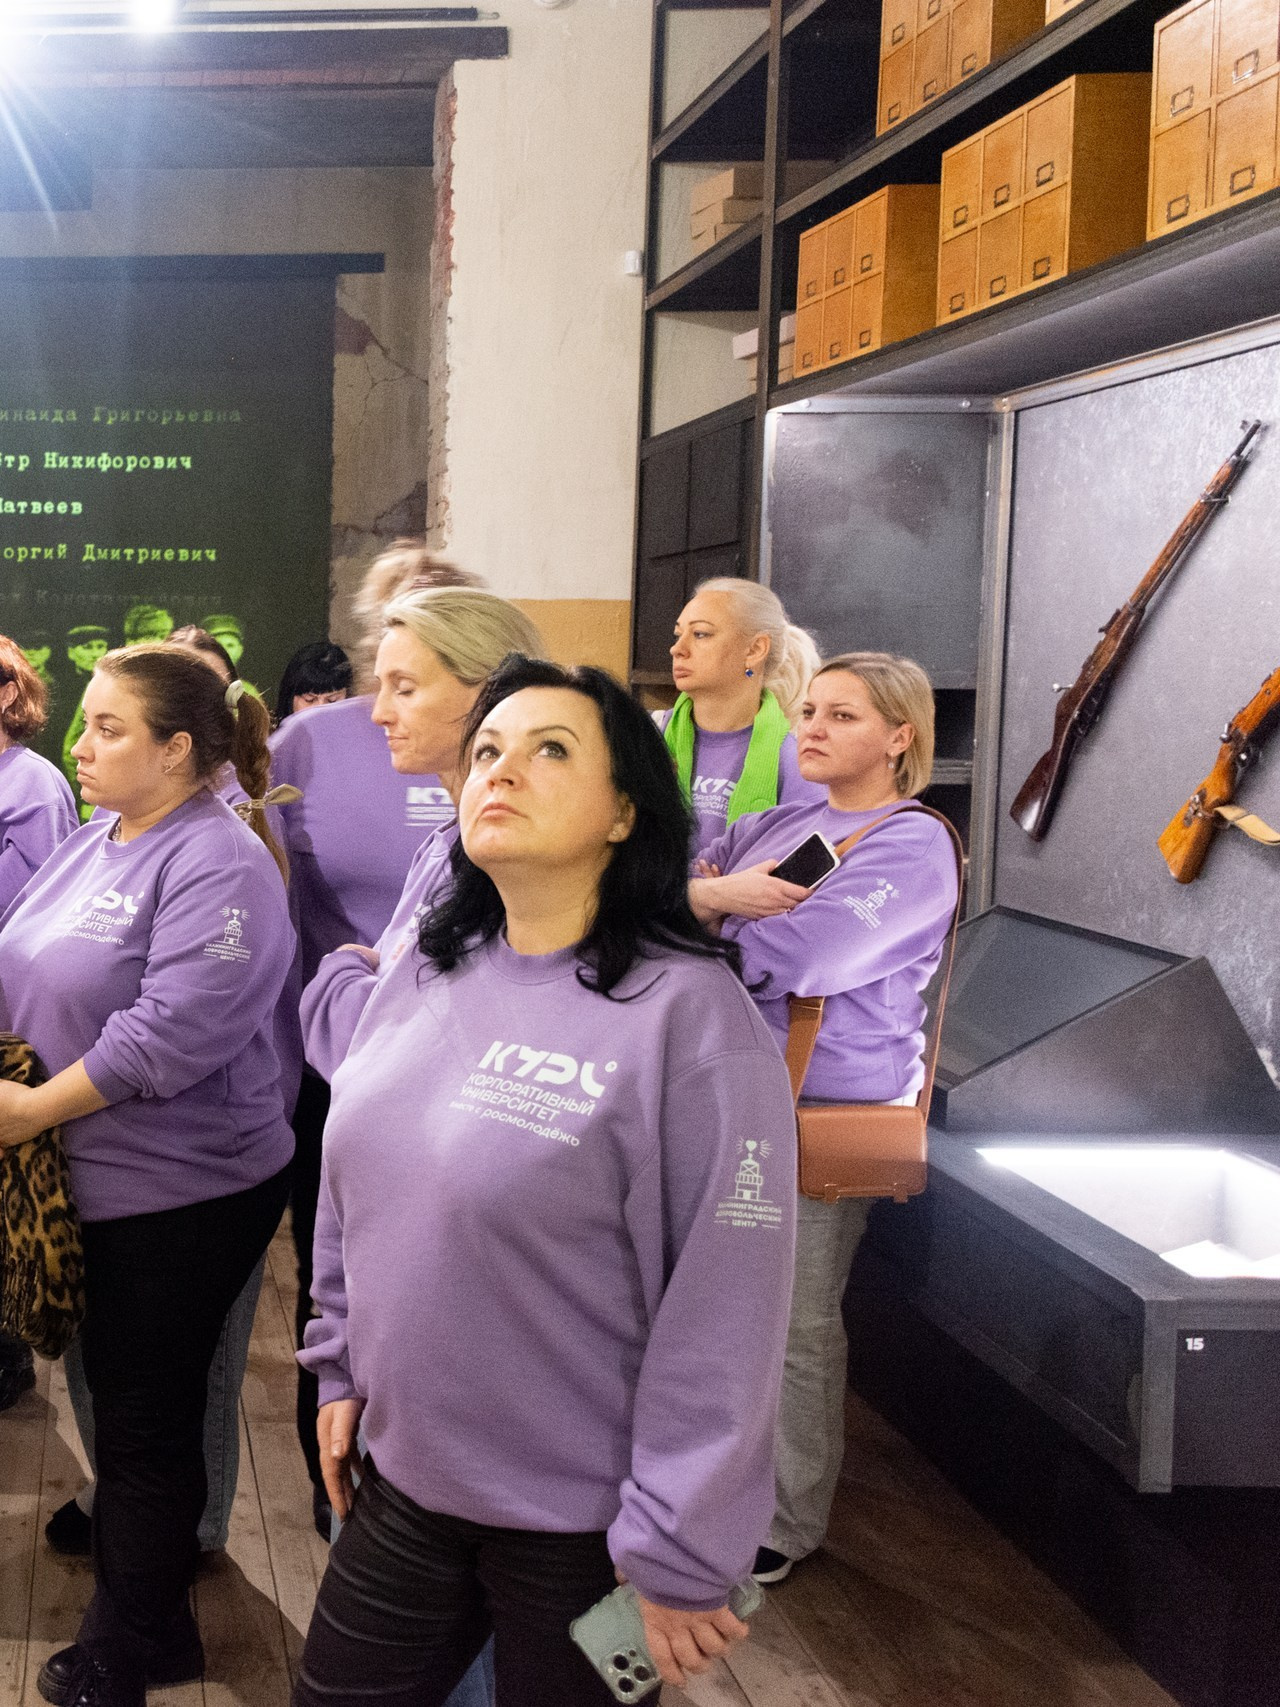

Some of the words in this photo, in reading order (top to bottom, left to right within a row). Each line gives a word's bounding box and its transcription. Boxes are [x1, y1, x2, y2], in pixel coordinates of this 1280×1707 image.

[92, 405, 241, 426] Григорьевна
[44, 451, 193, 472] Никифорович
[82, 543, 218, 563] Дмитриевич
[459, 1085, 562, 1123] УНИВЕРСИТЕТ
[466, 1072, 597, 1116] КОРПОРАТИВНЫЙ
[480, 1108, 581, 1147] росмолодёжь
[1185, 1337, 1205, 1351] 15
